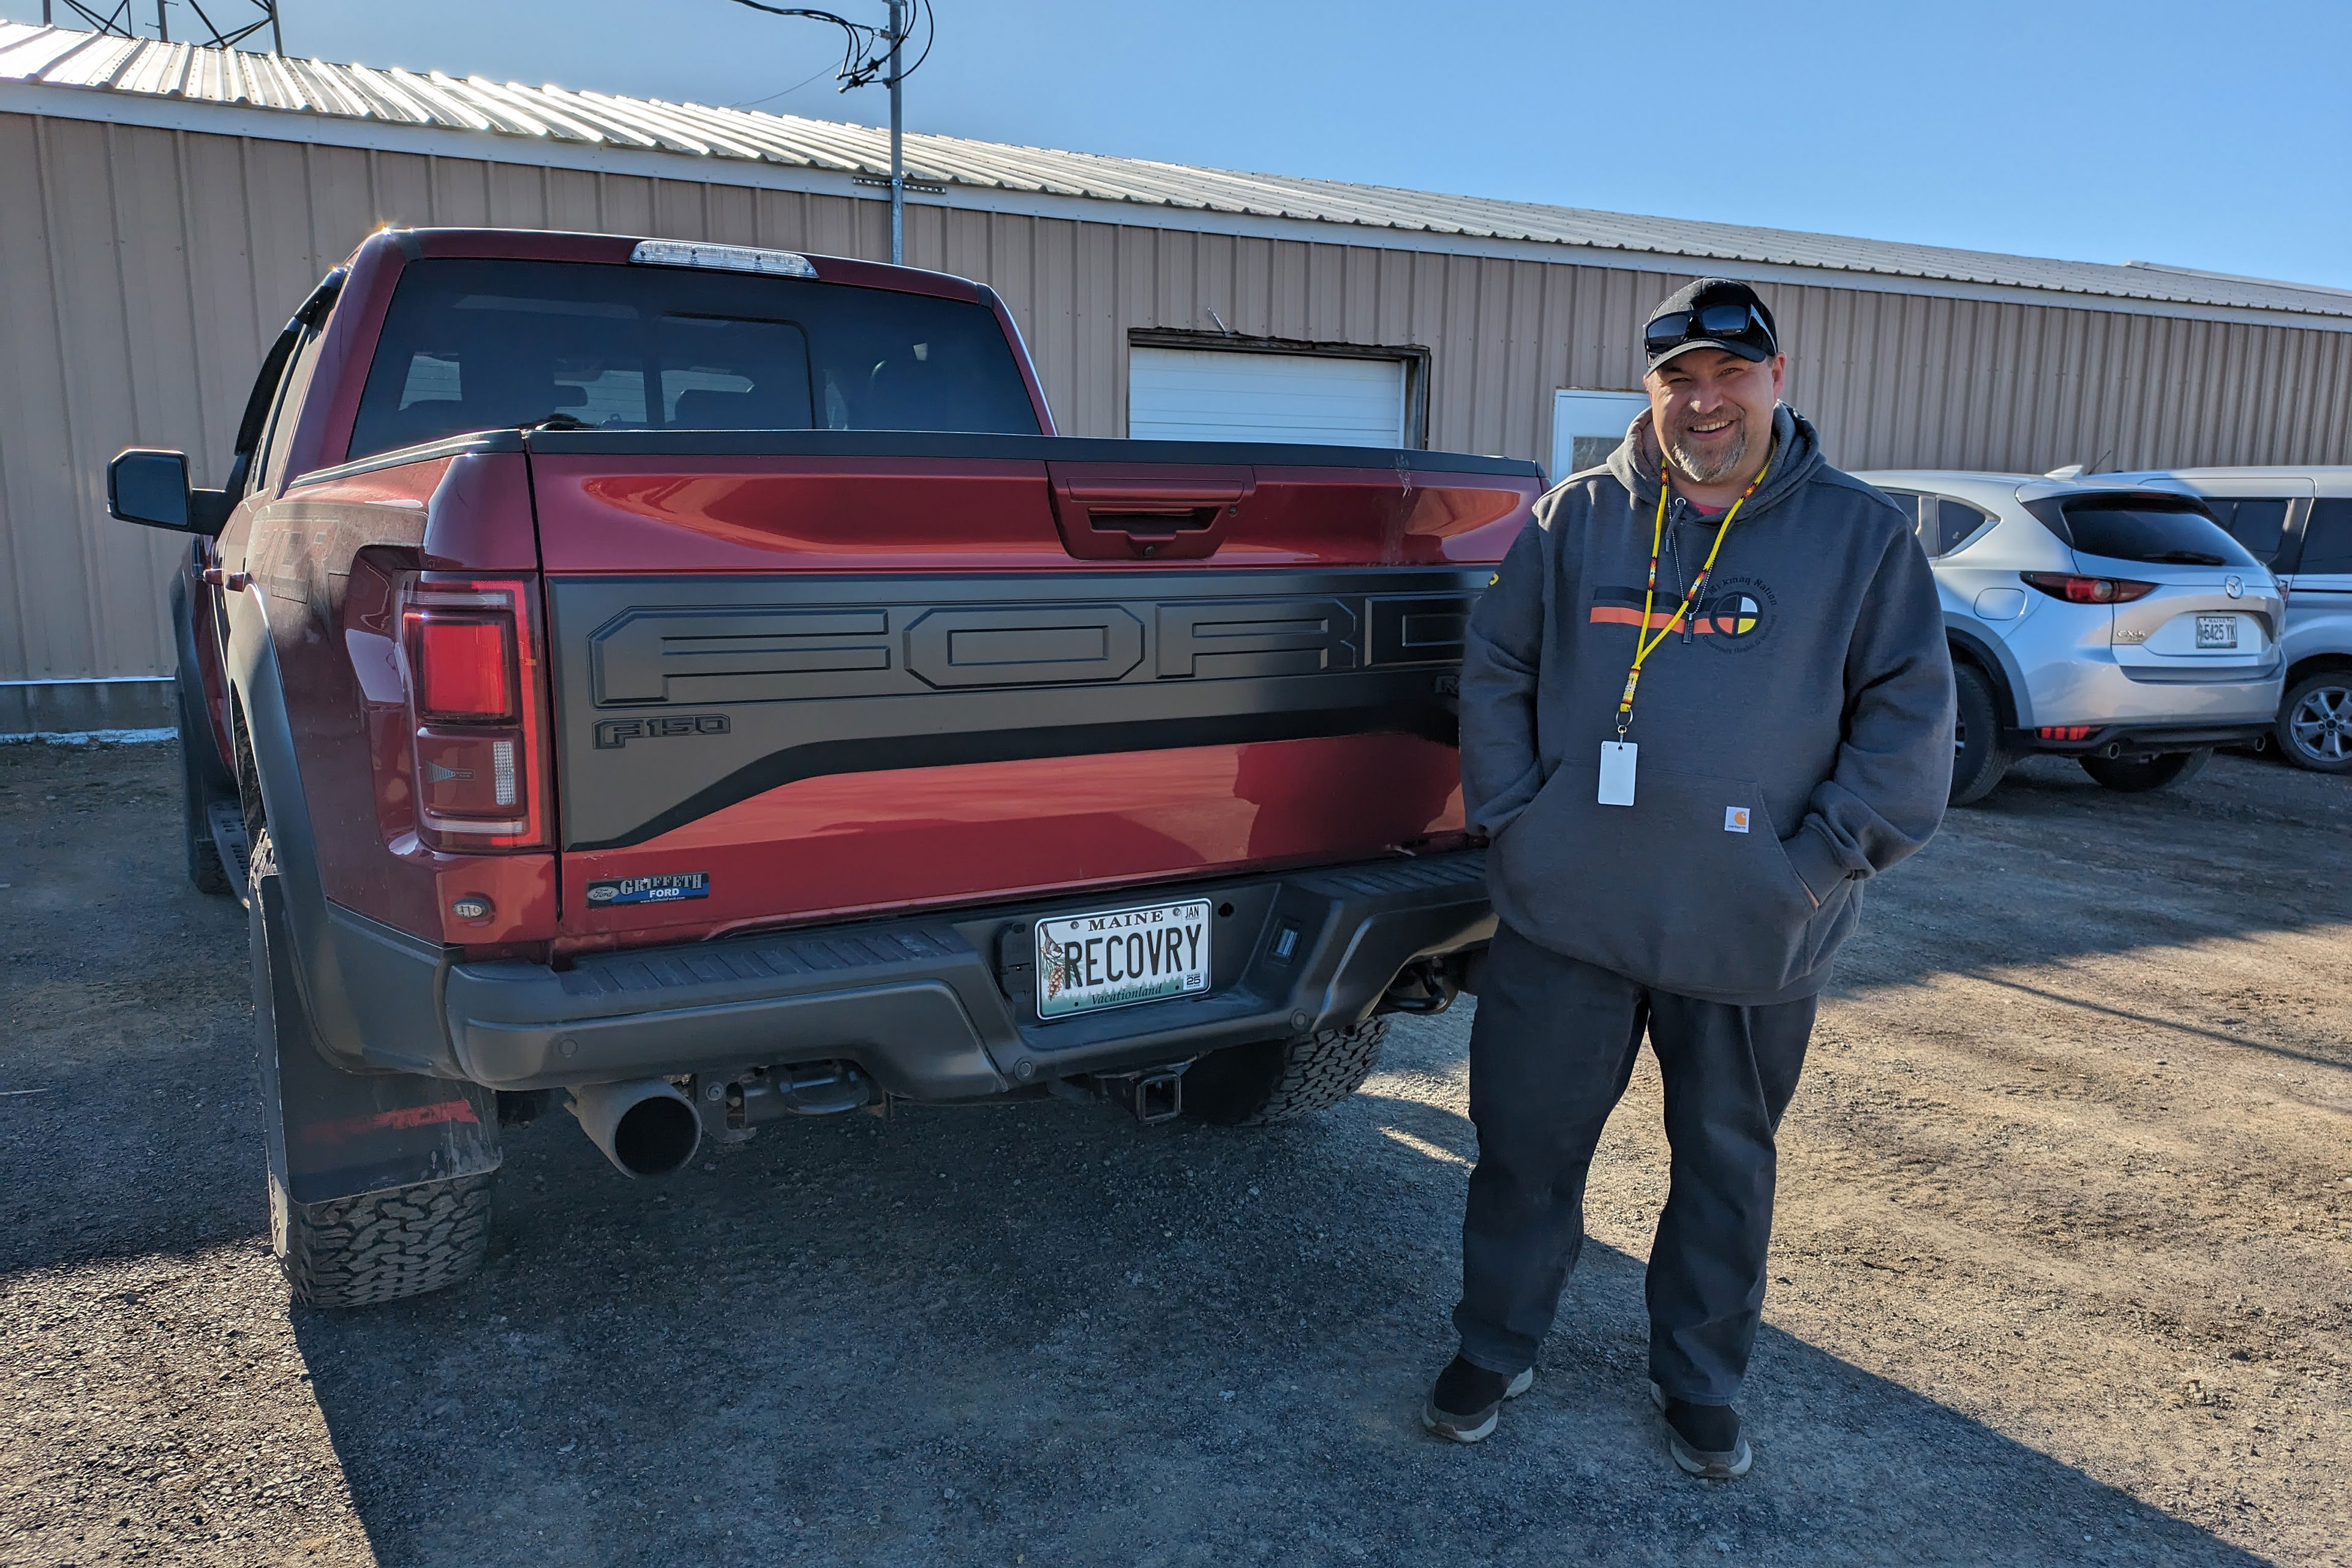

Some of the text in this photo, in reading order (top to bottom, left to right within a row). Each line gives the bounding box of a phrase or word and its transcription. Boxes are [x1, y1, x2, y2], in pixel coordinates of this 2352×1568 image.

[2205, 624, 2236, 640] 5425 YK
[620, 874, 703, 895] GRIFFETH
[593, 889, 613, 899] Ford
[649, 888, 680, 899] FORD
[1185, 906, 1199, 919] JAN
[1088, 911, 1164, 932] MAINE
[1064, 924, 1202, 990] RECOVRY
[1186, 976, 1201, 986] 25
[1091, 983, 1163, 1006] Vacationland
